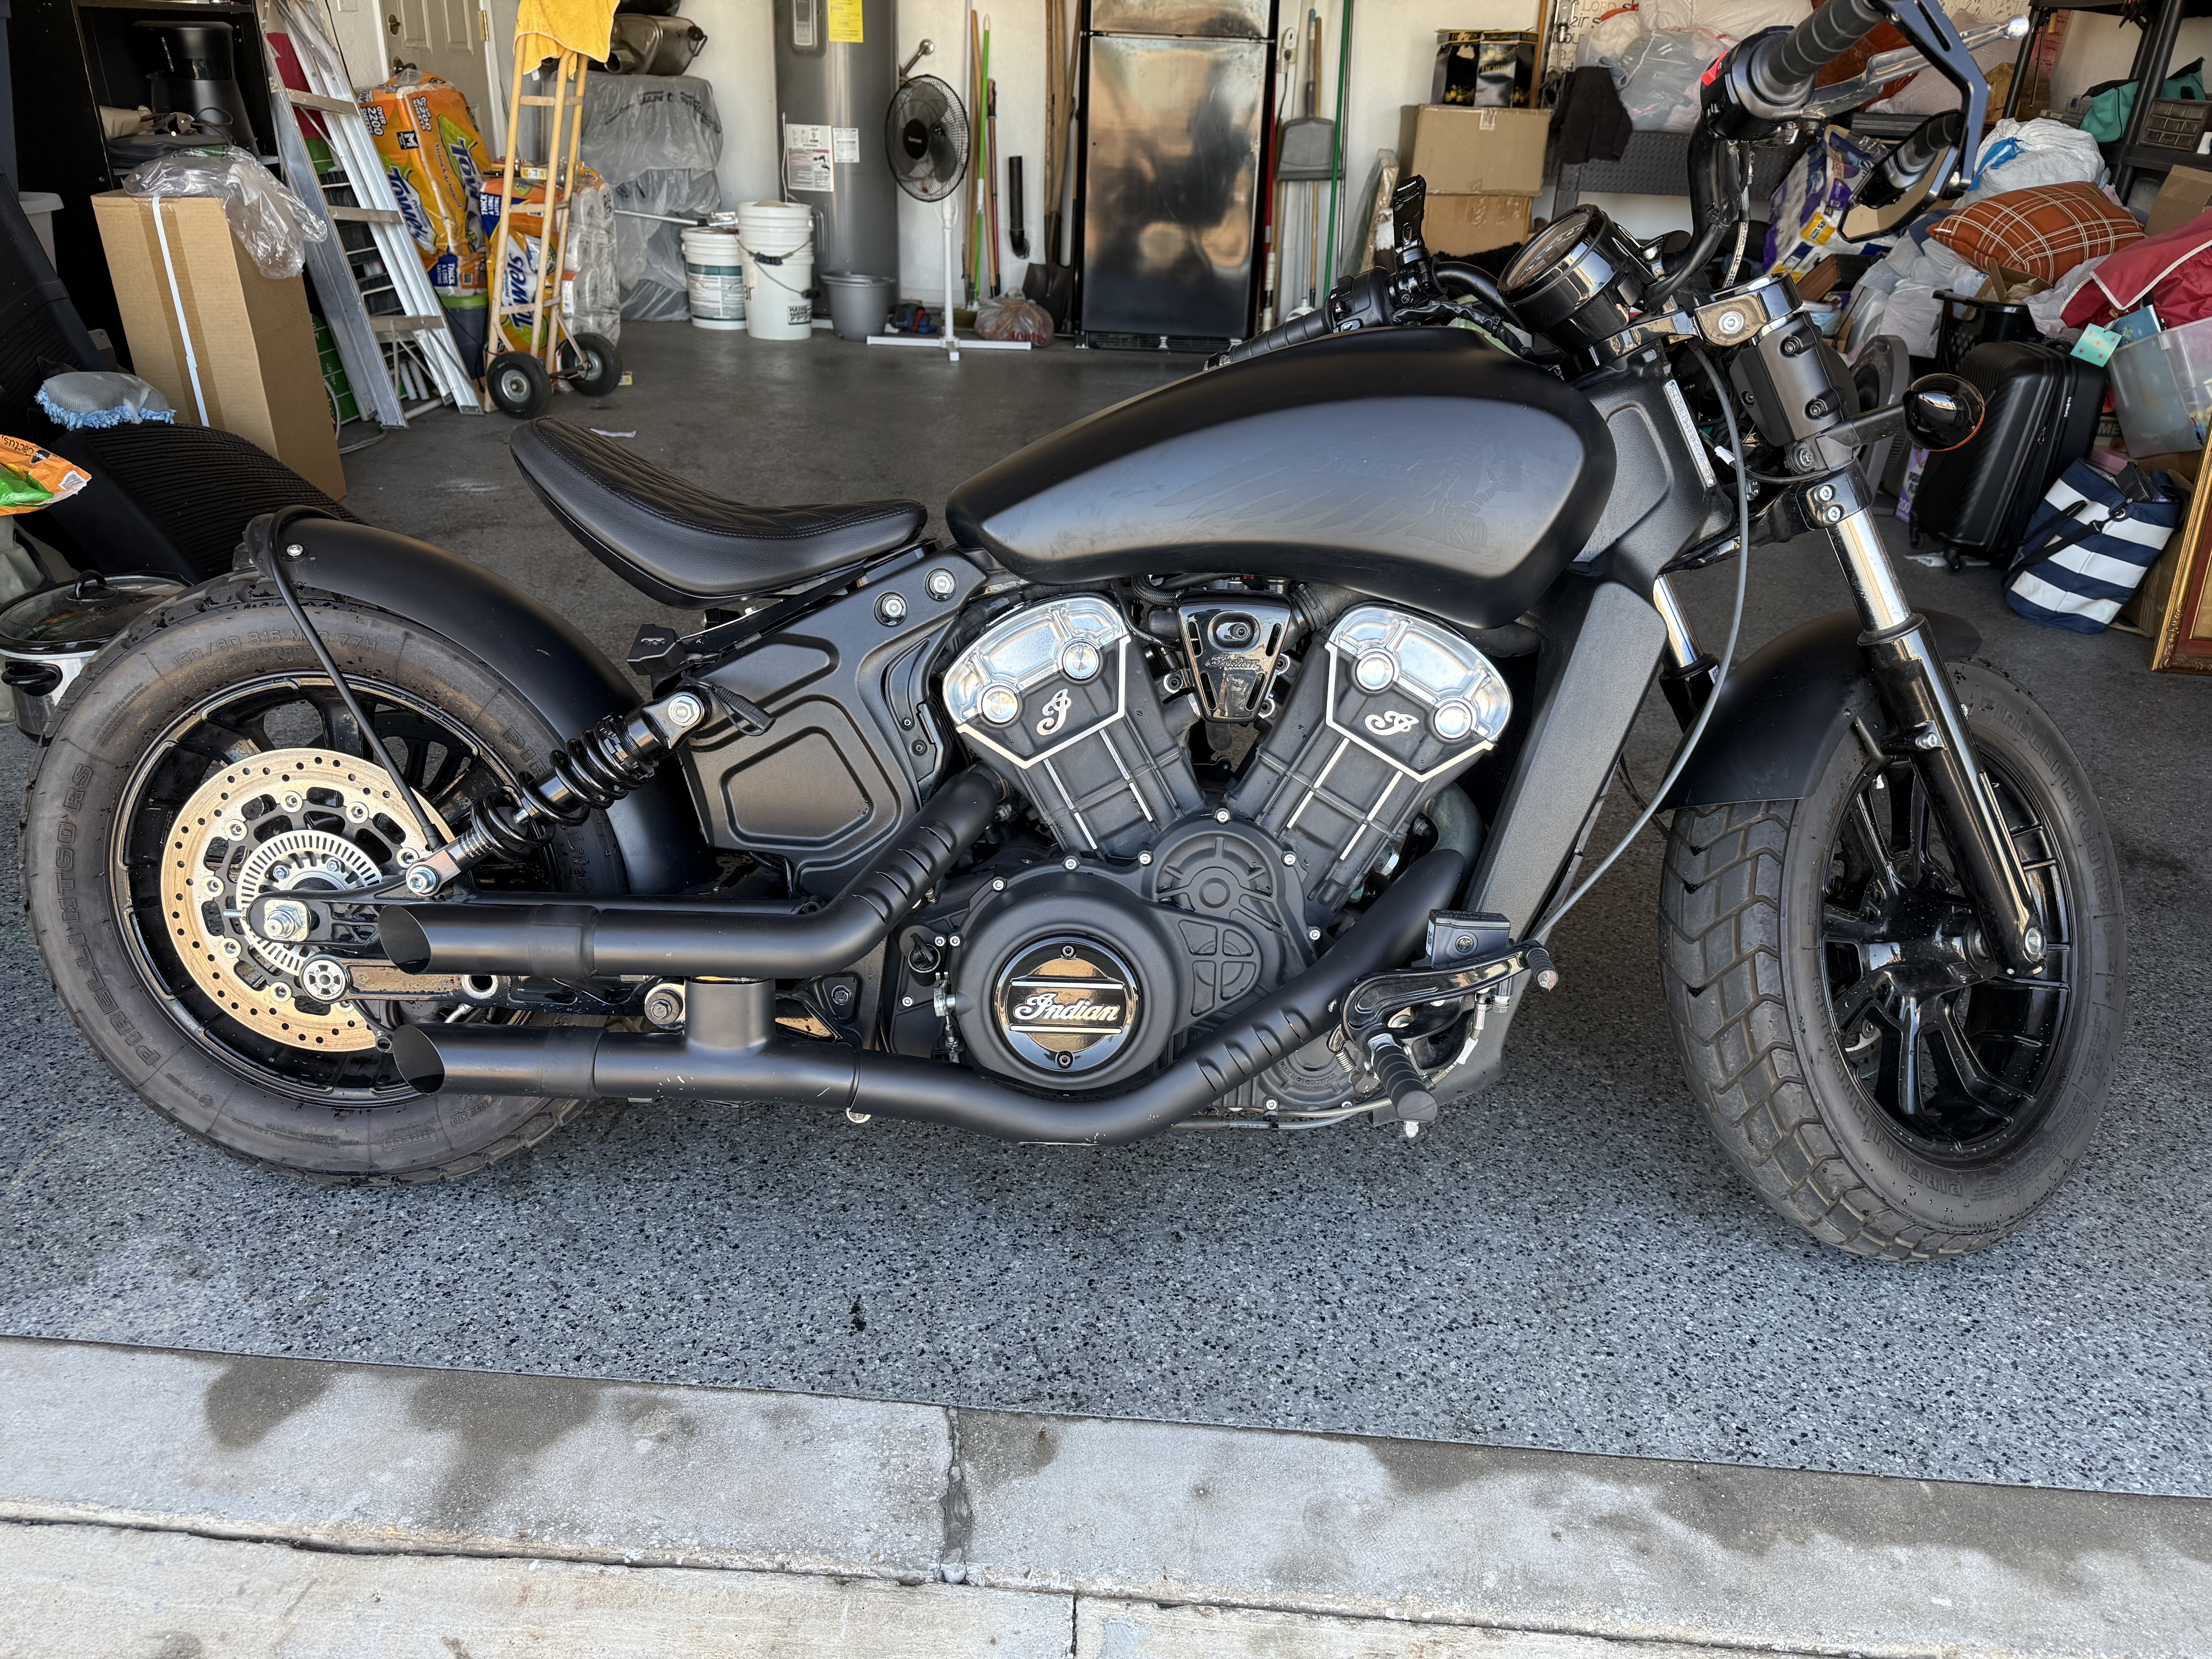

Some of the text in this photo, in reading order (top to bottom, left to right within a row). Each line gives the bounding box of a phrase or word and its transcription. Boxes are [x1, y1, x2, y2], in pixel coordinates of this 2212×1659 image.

[368, 106, 384, 136] 2200
[377, 105, 387, 125] OVER
[480, 194, 488, 215] THICK
[1, 435, 34, 457] Cactus,
[249, 630, 282, 644] B16
[339, 632, 377, 653] 77H
[1979, 698, 2061, 775] PIRELLI
[55, 764, 161, 1066] PIRELLI MT60 RS
[1013, 992, 1120, 1021] Indian
